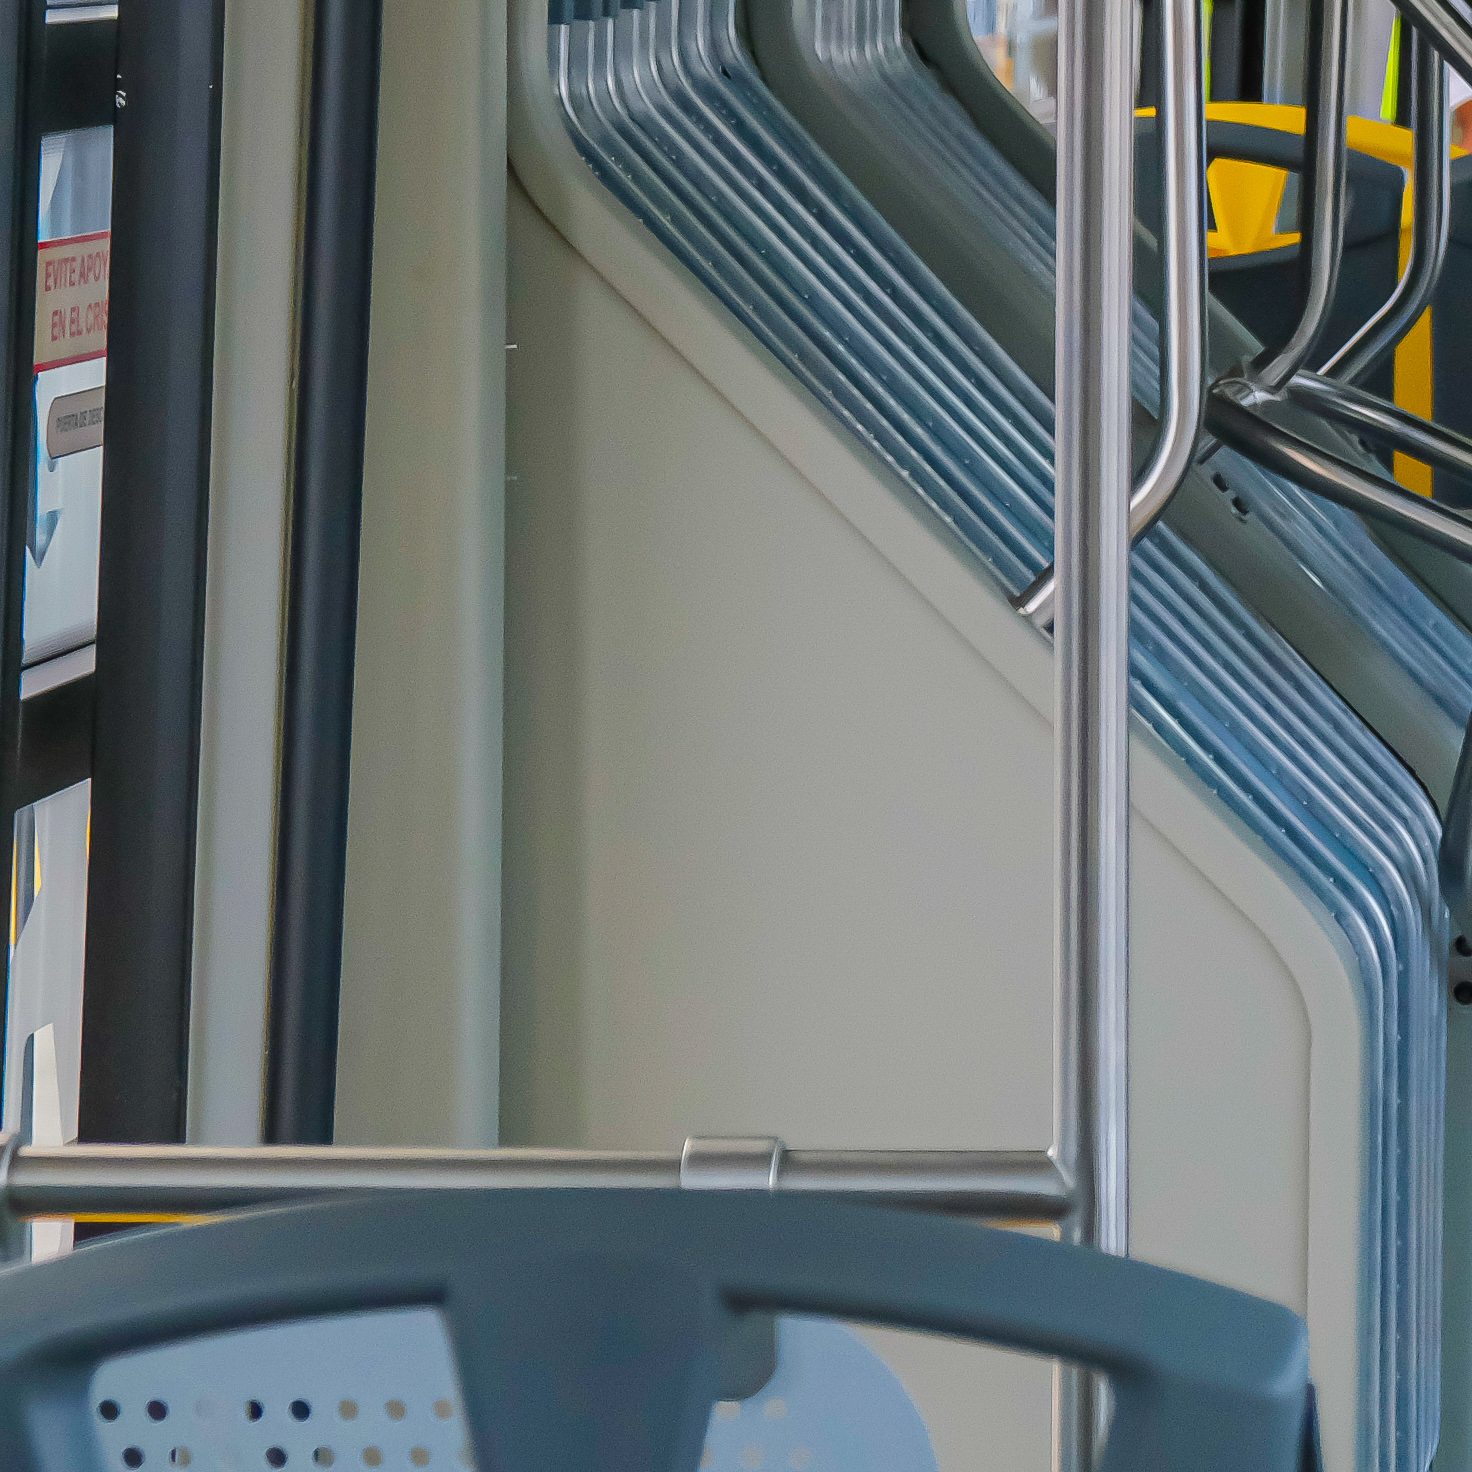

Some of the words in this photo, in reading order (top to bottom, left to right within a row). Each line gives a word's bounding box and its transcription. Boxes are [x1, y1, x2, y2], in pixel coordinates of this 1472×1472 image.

[45, 255, 77, 292] EVITE
[78, 249, 109, 287] APOY
[51, 309, 66, 343] EN
[69, 305, 83, 338] EL
